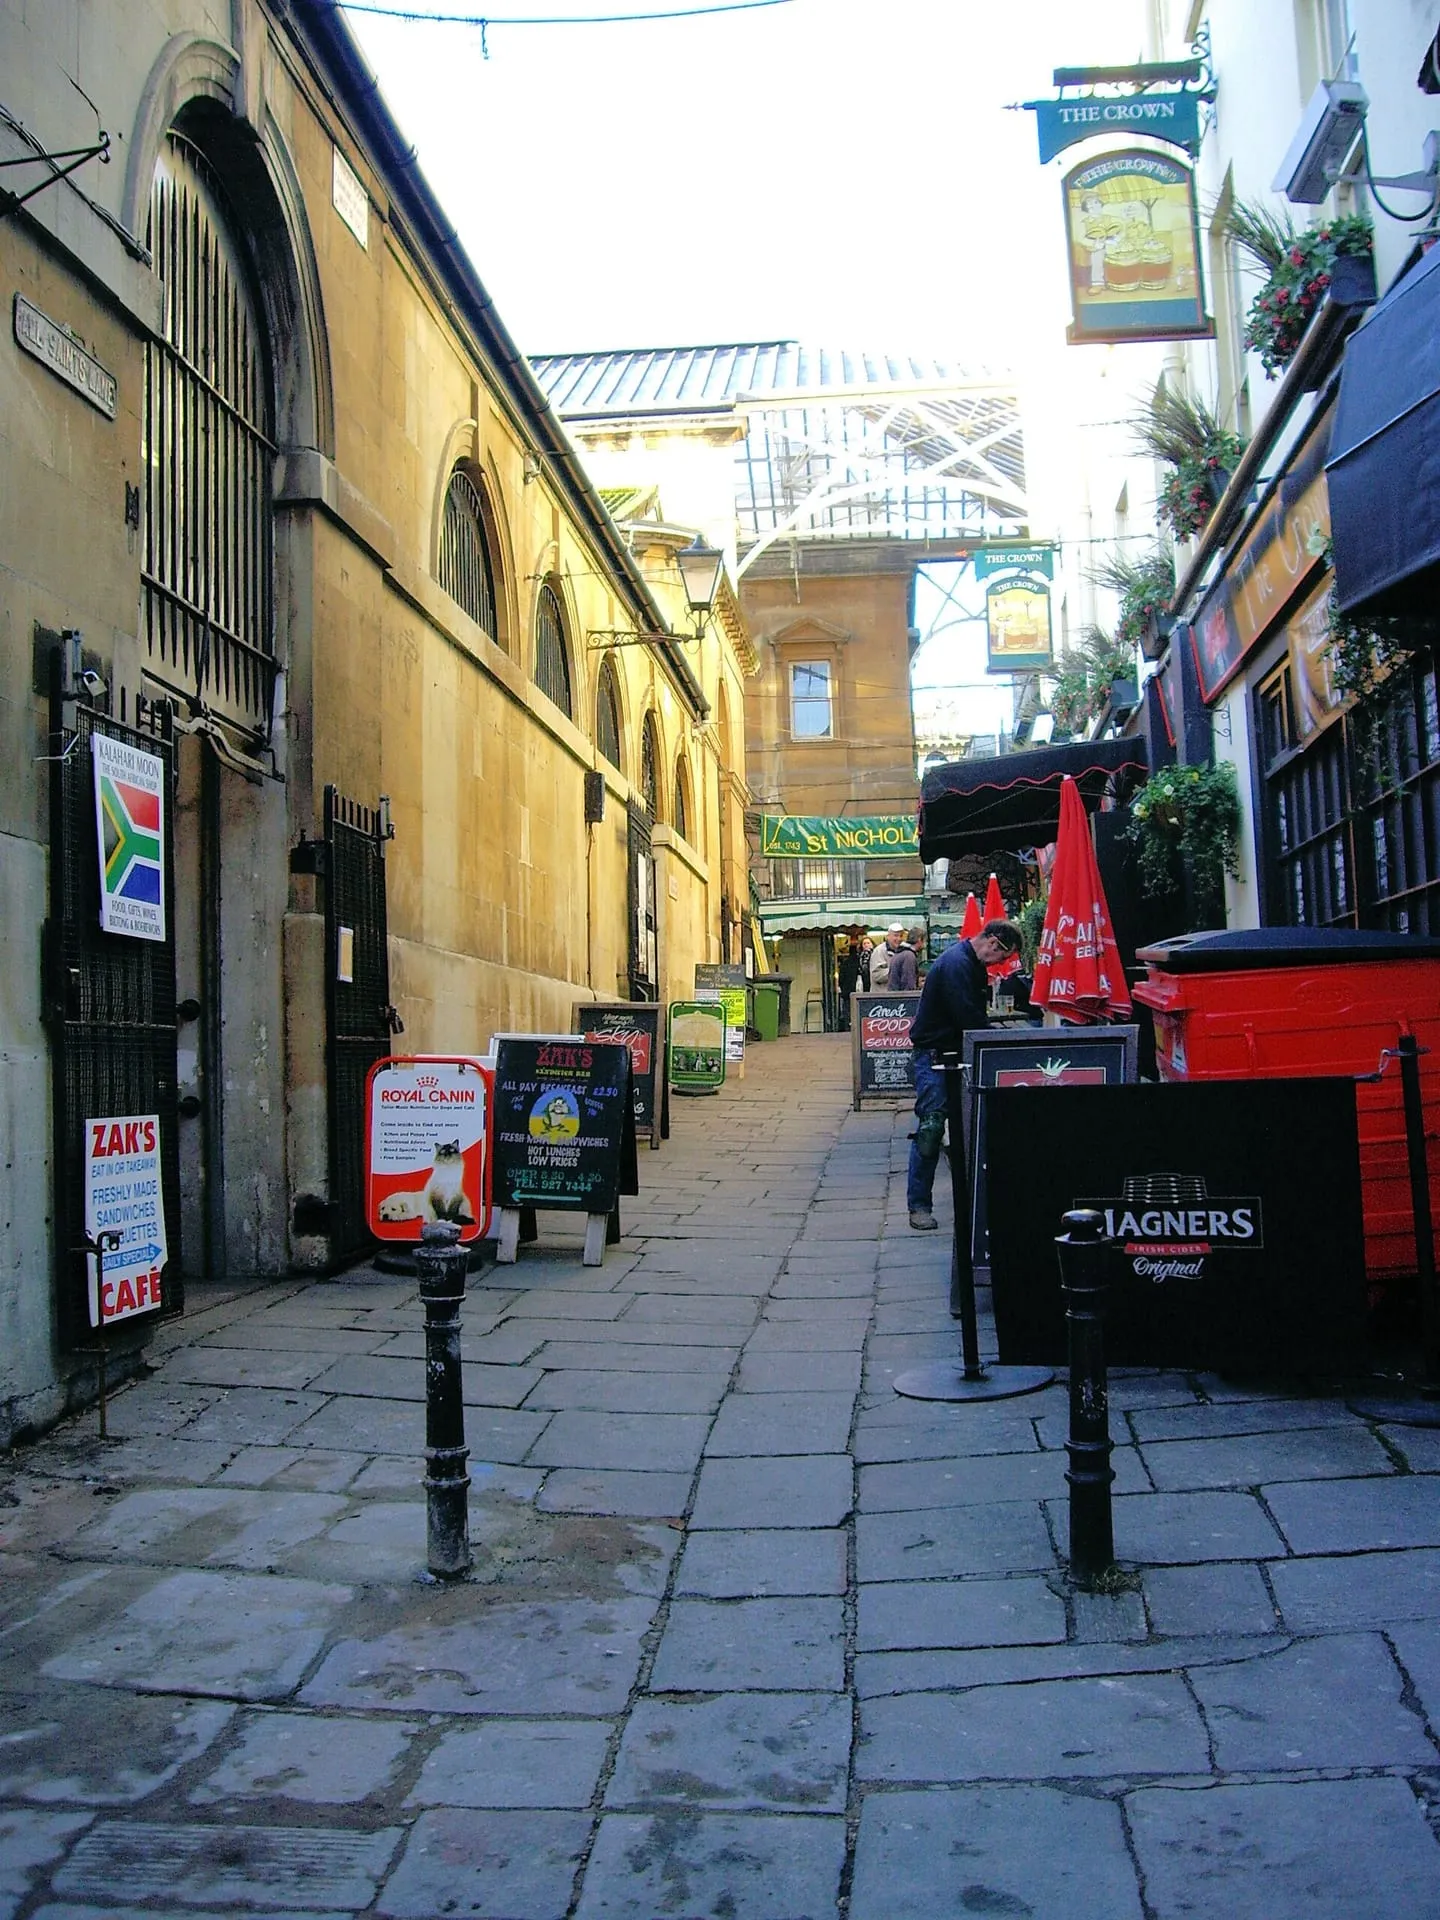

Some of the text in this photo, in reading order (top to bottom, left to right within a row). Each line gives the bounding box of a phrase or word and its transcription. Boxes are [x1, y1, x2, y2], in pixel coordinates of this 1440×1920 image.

[1059, 102, 1175, 123] THE CROWN
[47, 332, 87, 384] SAINTS
[88, 366, 115, 409] LANE
[985, 553, 1043, 564] THE CROWN
[996, 581, 1040, 593] THE CROWN
[98, 740, 160, 779] KALAHARI MOON
[807, 834, 829, 853] St
[869, 1003, 907, 1017] Great
[867, 1018, 911, 1032] FOOD
[536, 1046, 593, 1068] ZAK'S
[502, 1081, 517, 1091] ALL
[520, 1082, 537, 1093] DAY
[381, 1090, 475, 1103] ROYAL CANIN
[92, 1121, 156, 1158] ZAK'S
[500, 1132, 525, 1143] FRESH
[527, 1145, 581, 1158] HOT LUNCHES
[92, 1158, 157, 1178] EAT IN OR TAKEAWAY
[527, 1156, 578, 1168] LOW PRICES
[515, 1178, 593, 1192] TEL: 927 7444
[92, 1180, 158, 1206] FRESHLY MADE
[96, 1201, 156, 1227] SANDWICHES
[1133, 1245, 1202, 1254] IRISH CIDER
[1132, 1256, 1205, 1284] Original
